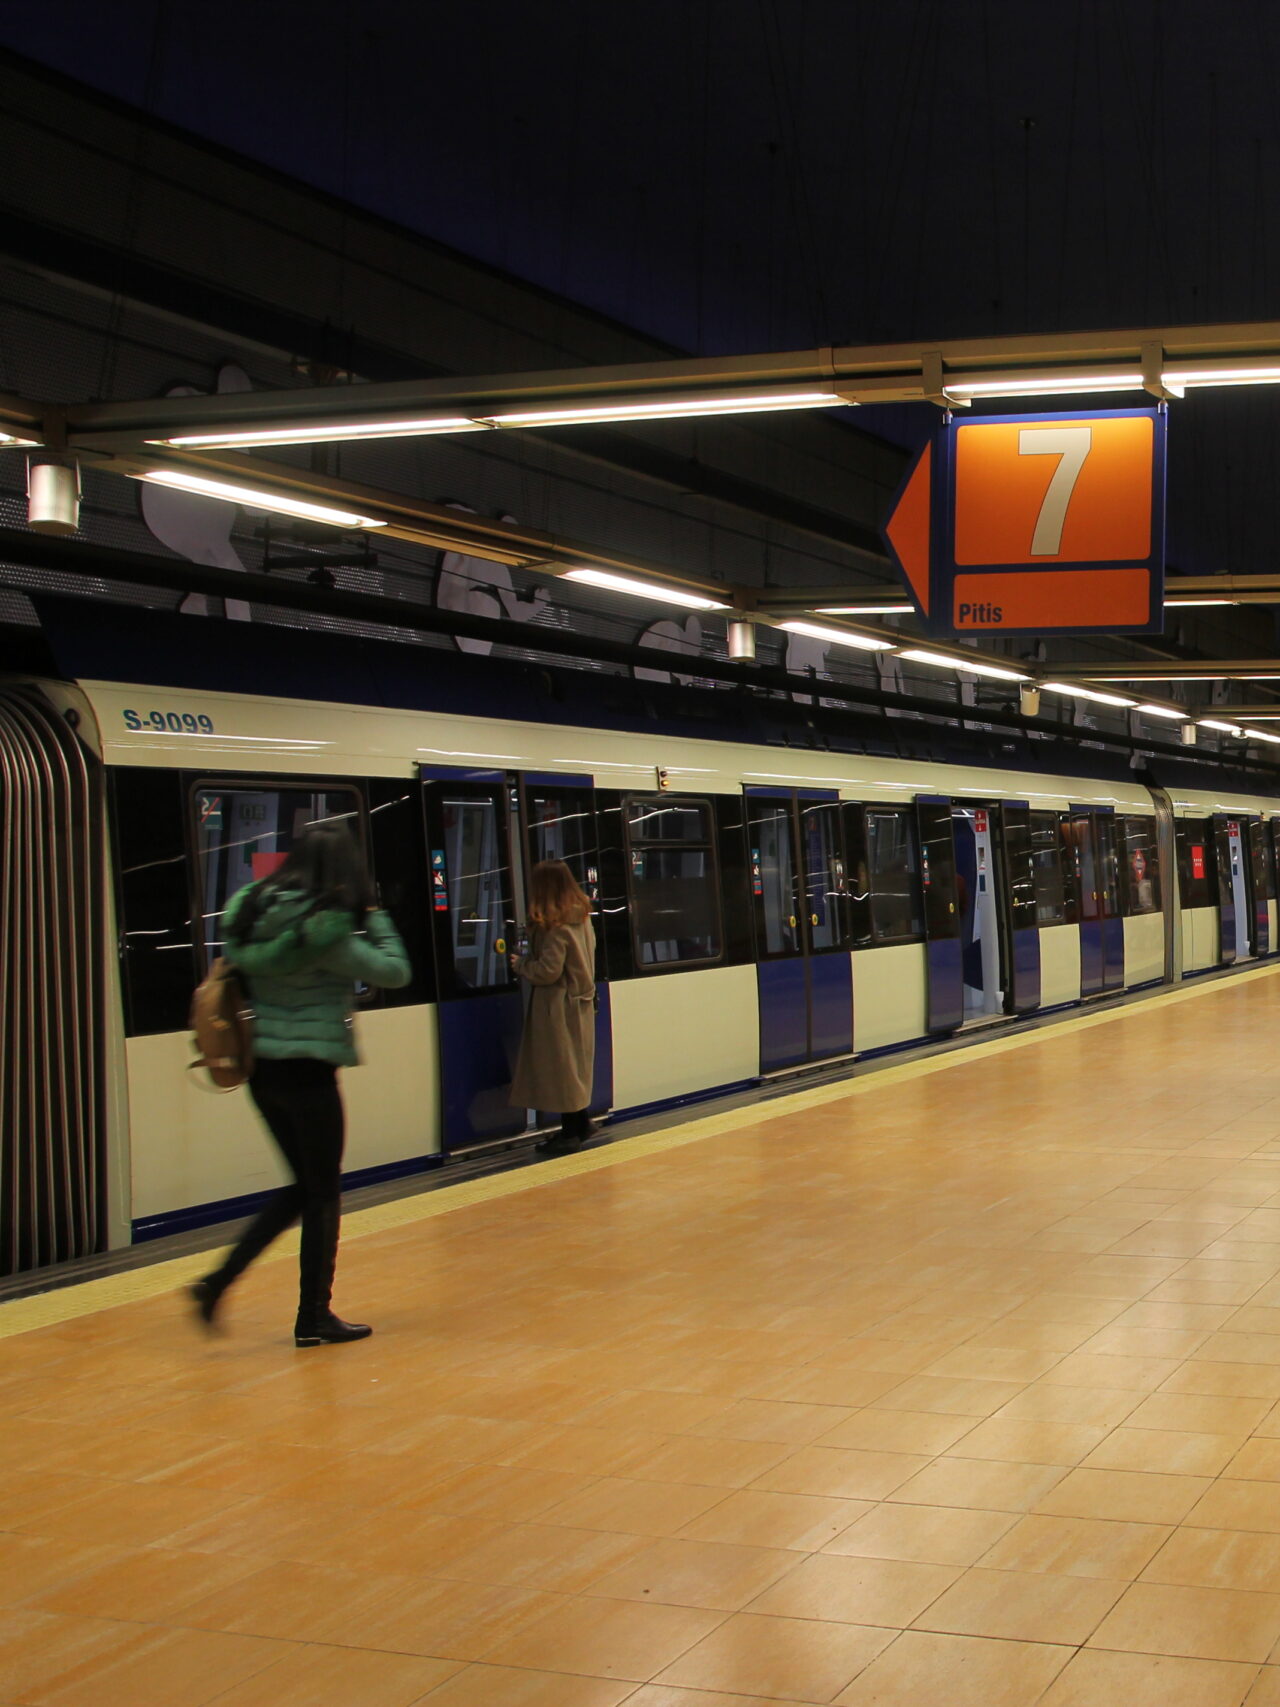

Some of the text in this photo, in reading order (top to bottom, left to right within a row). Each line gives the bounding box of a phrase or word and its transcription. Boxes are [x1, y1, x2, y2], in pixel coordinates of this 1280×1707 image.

[1018, 426, 1092, 557] 7
[958, 602, 1003, 624] Pitis
[123, 708, 214, 735] S-9099
